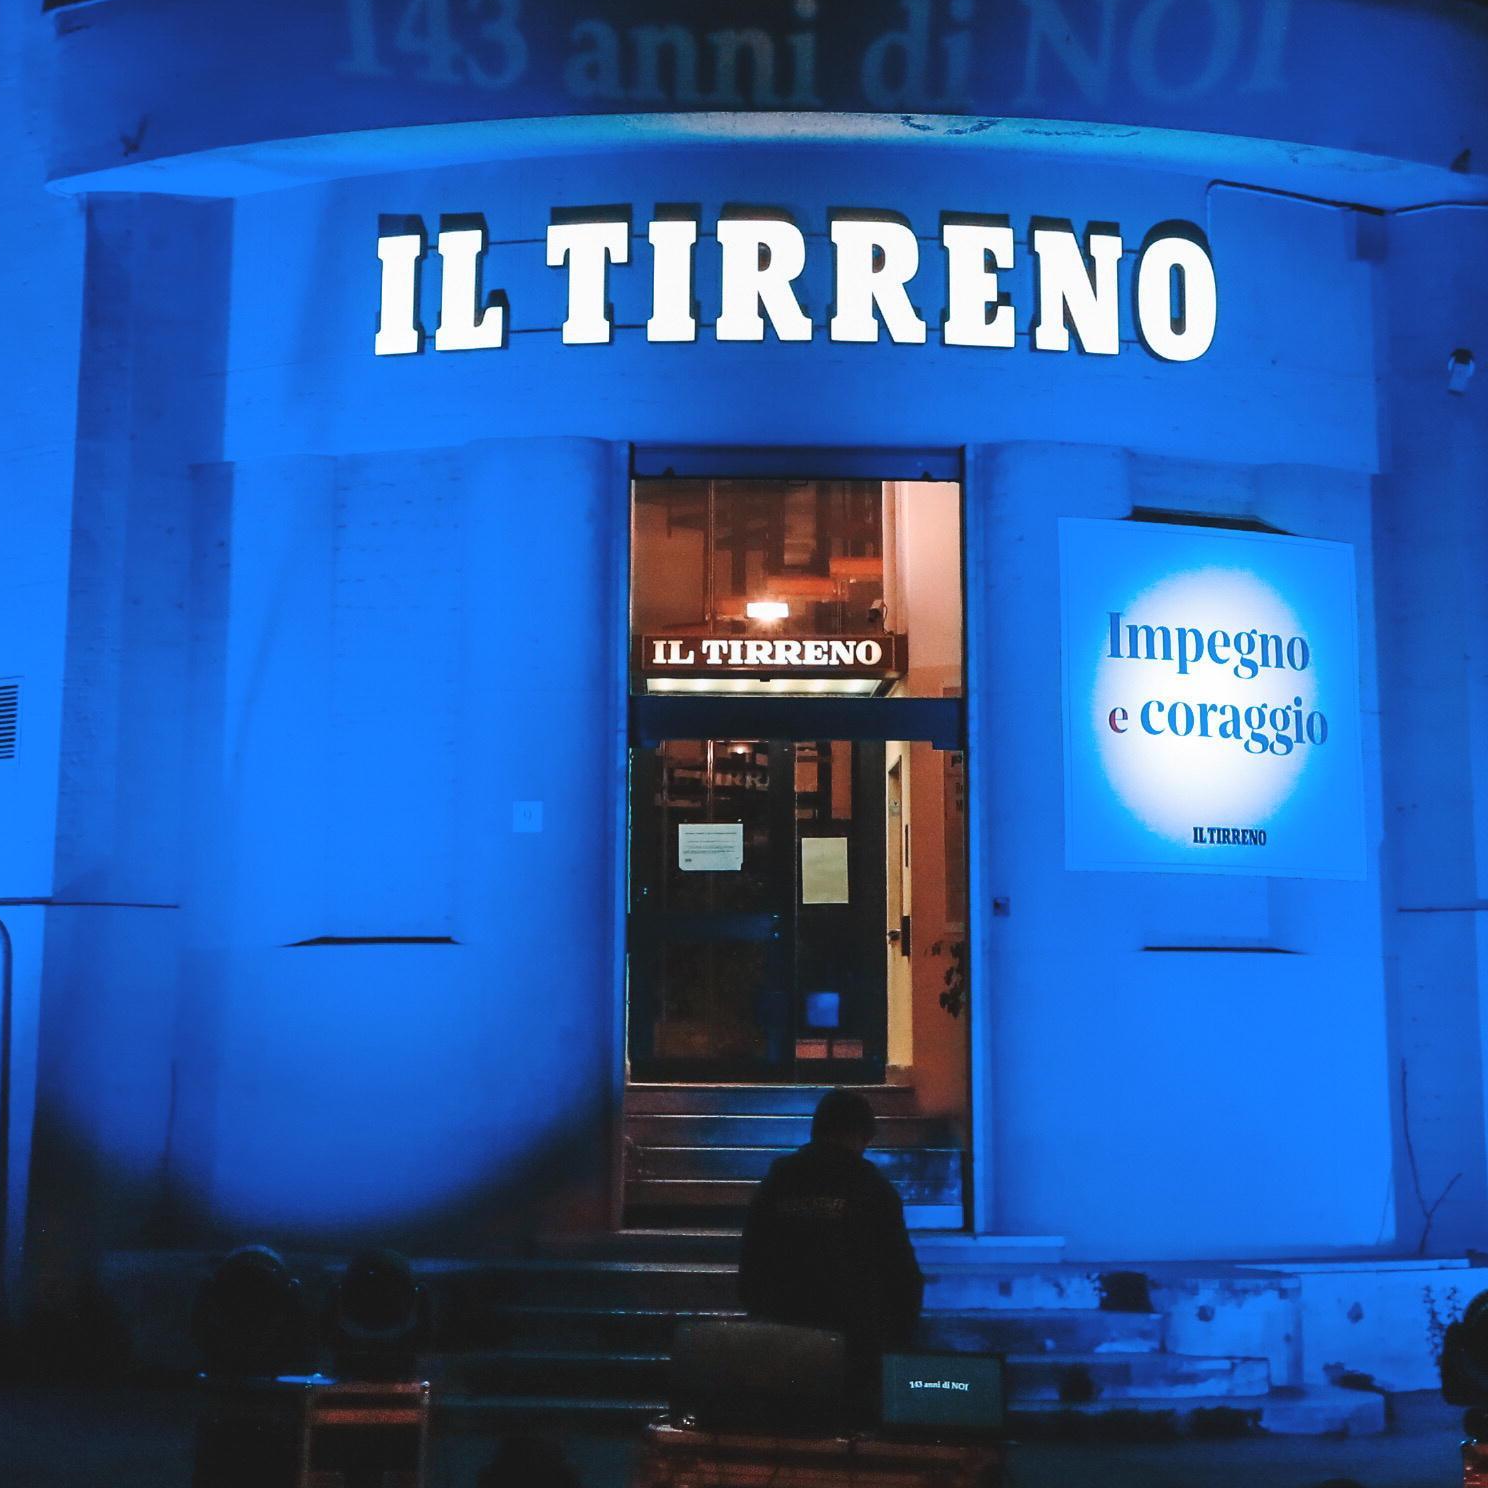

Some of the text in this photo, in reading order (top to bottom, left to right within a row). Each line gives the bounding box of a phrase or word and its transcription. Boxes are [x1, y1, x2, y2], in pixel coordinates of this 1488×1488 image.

[374, 217, 1218, 363] IL TIRRENO
[651, 638, 883, 666] IL TIRRENO
[1106, 610, 1312, 680] Impegno
[1107, 695, 1329, 756] e coraggio
[1192, 826, 1267, 847] IL TIRRENO
[923, 1380, 941, 1389] anni
[942, 1380, 951, 1390] di
[951, 1381, 970, 1392] NOI
